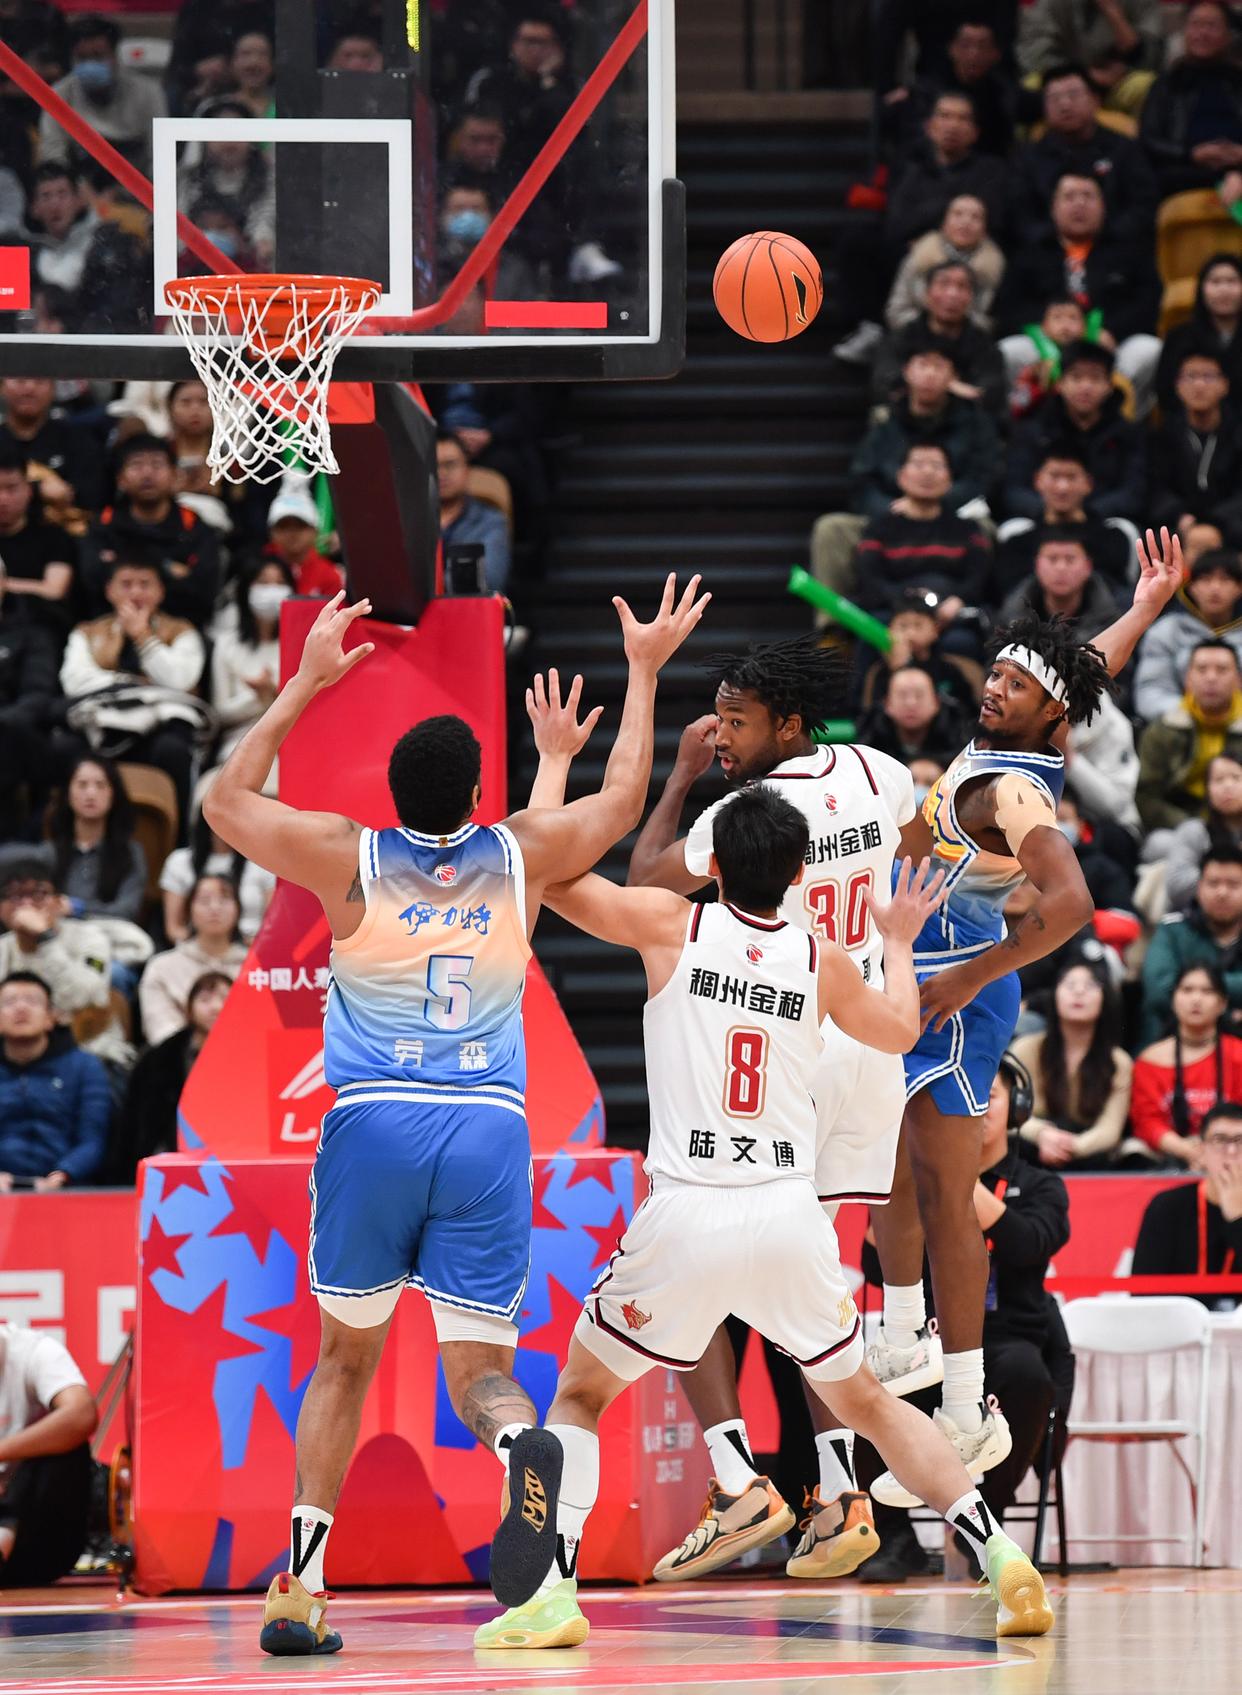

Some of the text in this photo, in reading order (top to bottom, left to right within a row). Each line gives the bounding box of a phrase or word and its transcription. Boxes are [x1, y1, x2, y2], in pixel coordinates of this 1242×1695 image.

[398, 901, 492, 935] 伊力特
[804, 867, 874, 952] 30
[423, 954, 474, 1032] 5
[689, 967, 806, 1021] 稠州金租
[722, 1024, 770, 1120] 8
